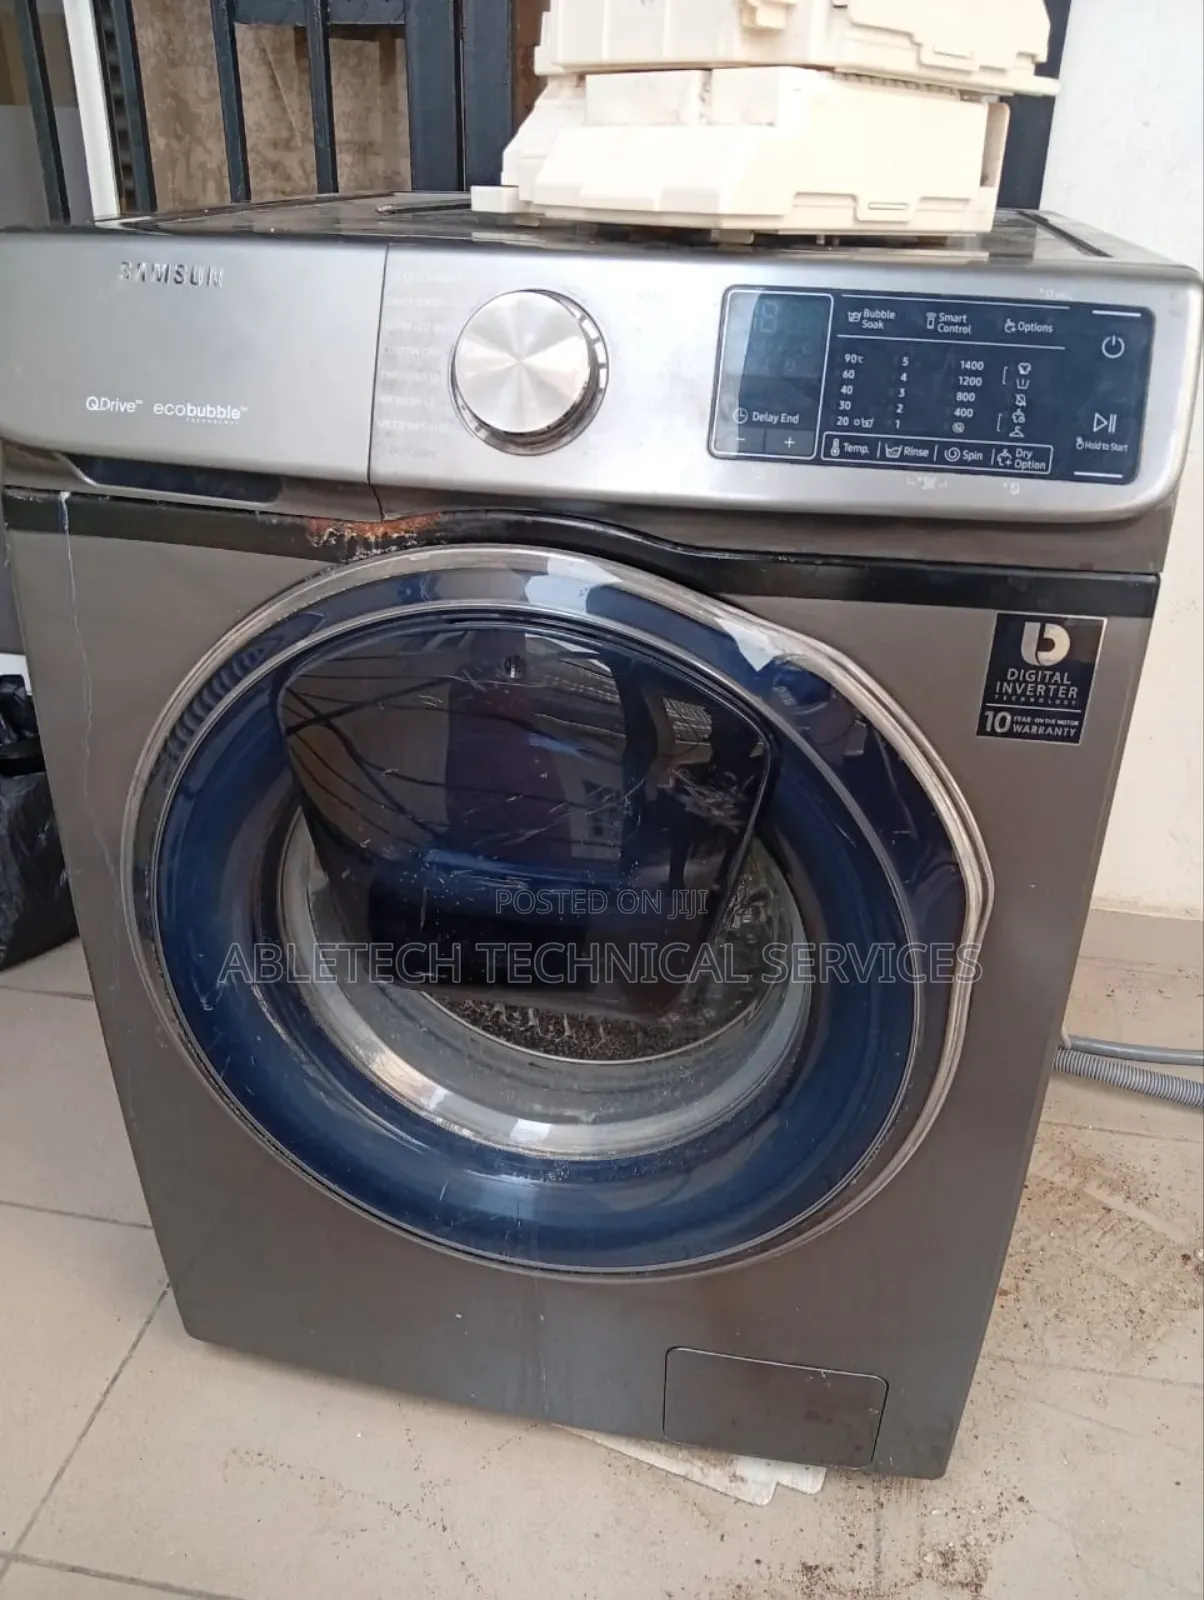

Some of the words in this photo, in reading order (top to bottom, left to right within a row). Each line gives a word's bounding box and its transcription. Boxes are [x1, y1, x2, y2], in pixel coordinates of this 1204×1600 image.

[863, 308, 896, 320] Bubble
[938, 312, 968, 323] Smart
[861, 319, 884, 330] Soak
[937, 323, 971, 335] Control
[1017, 321, 1053, 334] Options
[902, 356, 910, 367] 5
[960, 360, 985, 371] 1400
[842, 369, 856, 380] 60
[900, 372, 908, 382] 4
[958, 376, 983, 387] 1200
[840, 384, 854, 395] 40
[898, 387, 906, 398] 3
[955, 391, 976, 402] 800
[838, 400, 852, 411] 30
[896, 403, 904, 414] 2
[752, 411, 780, 425] Delay
[780, 413, 800, 424] End
[953, 407, 974, 418] 400
[836, 416, 850, 426] 20
[895, 419, 901, 430] 1
[1084, 440, 1102, 451] Hold
[1102, 442, 1110, 451] to
[903, 446, 929, 457] Rinse
[962, 450, 983, 462] Spin
[1015, 448, 1033, 460] Dry
[1014, 459, 1046, 472] Option
[1006, 668, 1071, 685] DIGITAL
[995, 681, 1079, 699] INVERTER
[984, 710, 1012, 733] 10
[1013, 723, 1077, 737] WARRANTY
